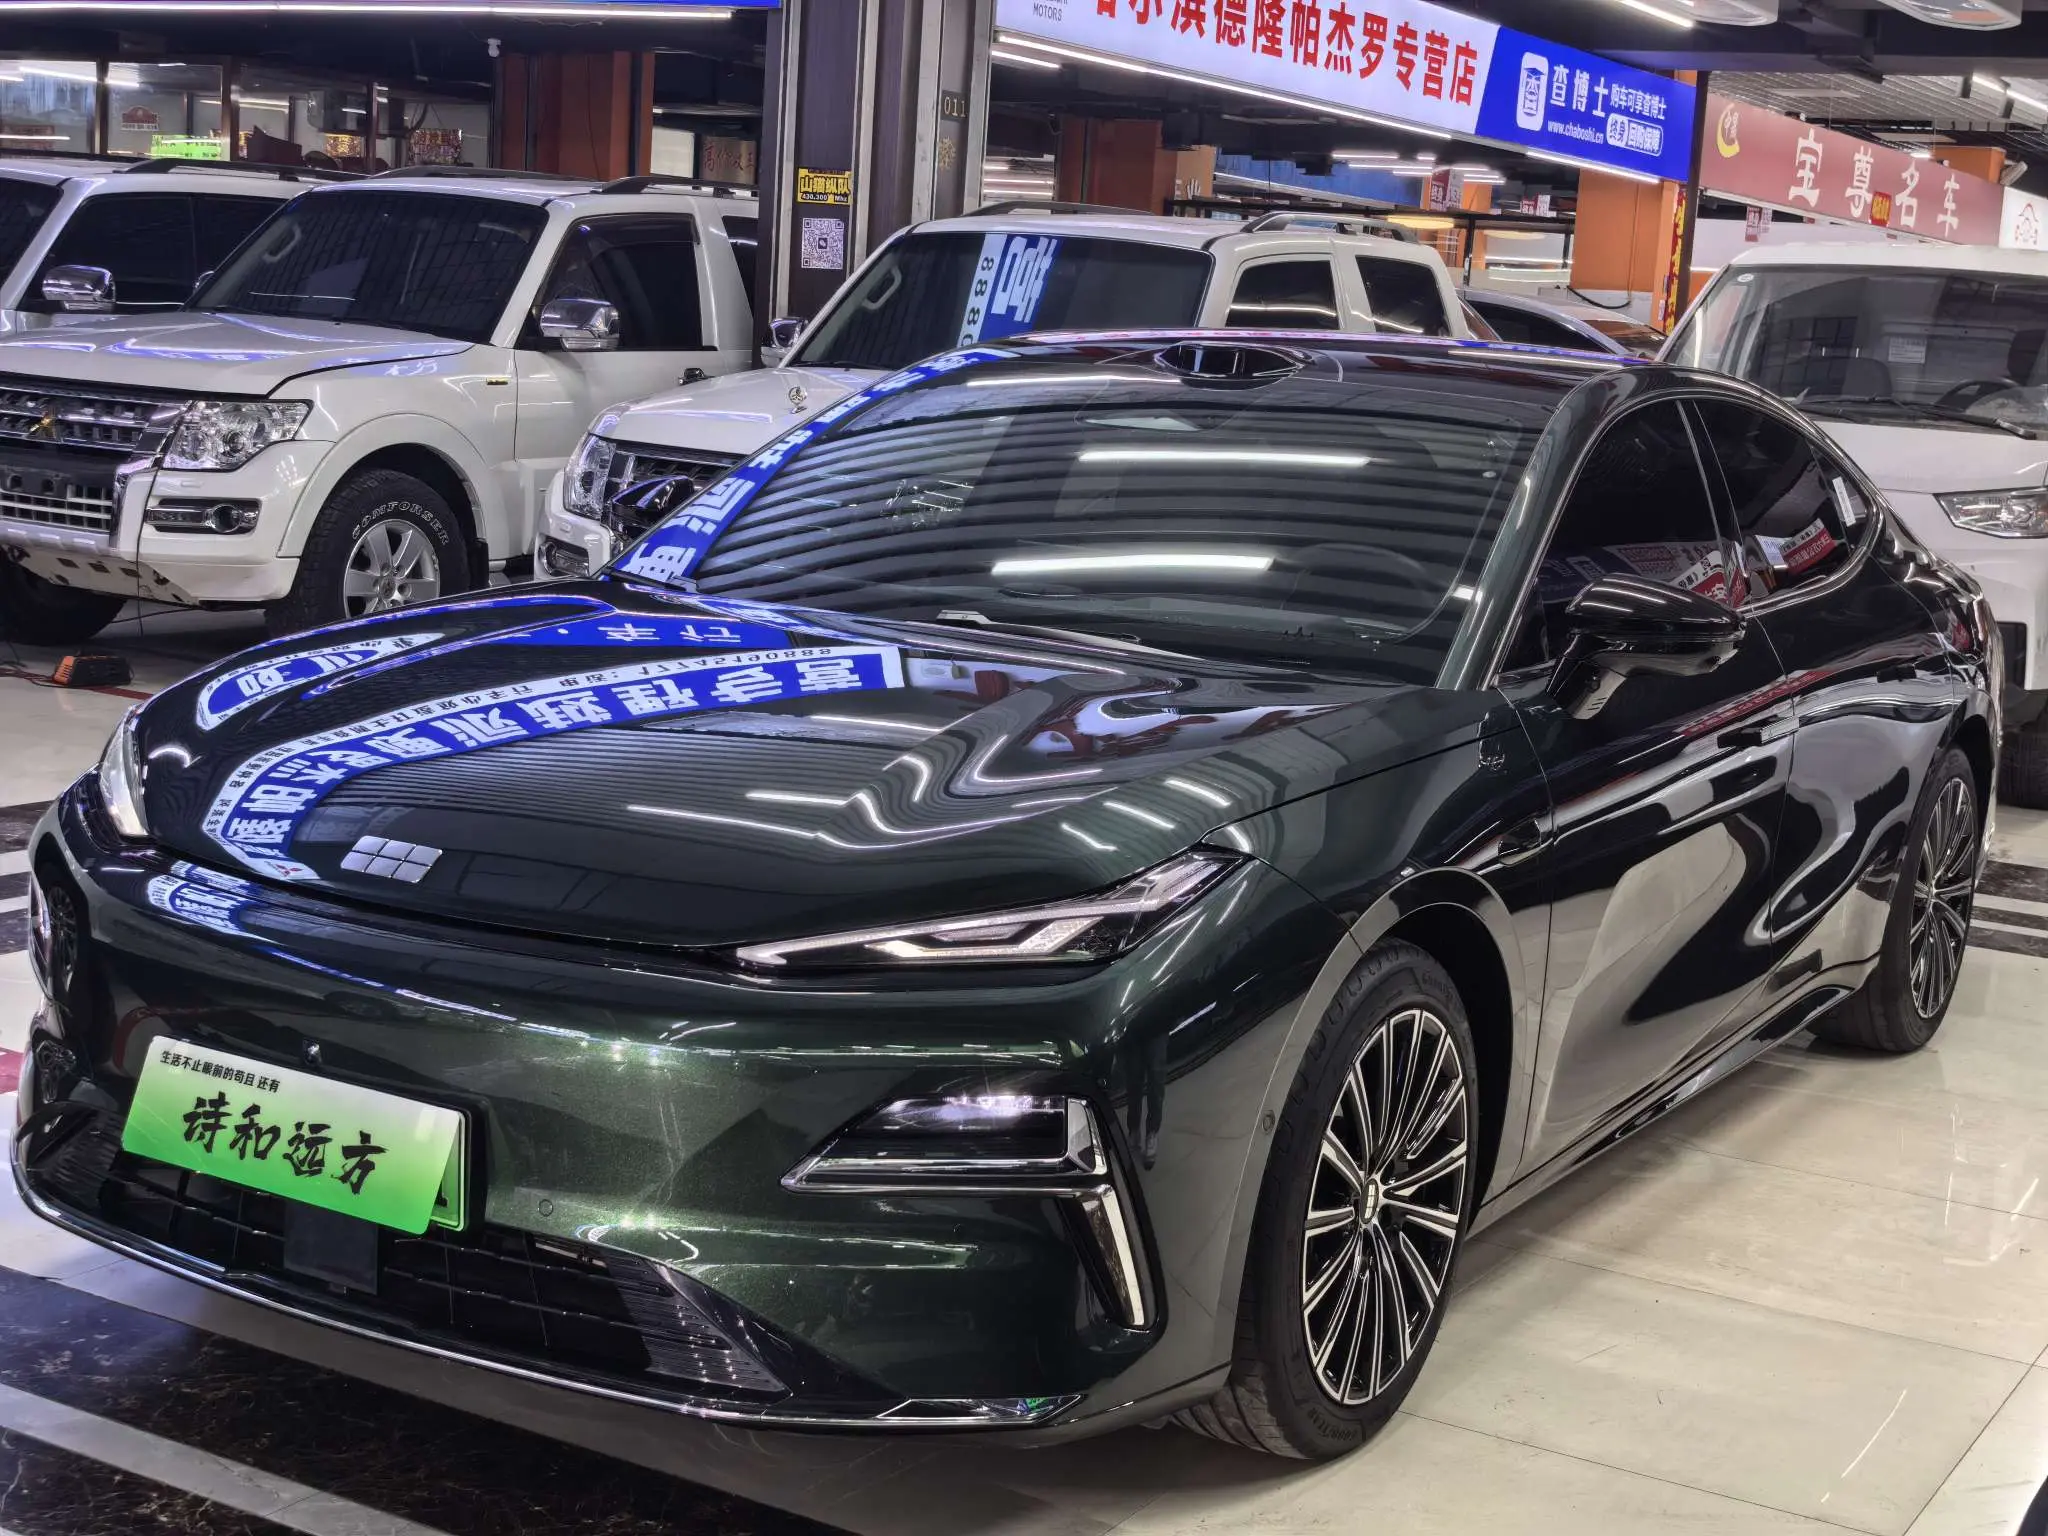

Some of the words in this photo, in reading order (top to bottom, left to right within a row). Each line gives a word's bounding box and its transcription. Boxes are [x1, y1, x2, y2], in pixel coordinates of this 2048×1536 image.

[1033, 3, 1063, 22] MOTORS
[1550, 64, 1608, 118] 查博士
[1610, 83, 1667, 120] 购车可享查博士
[1547, 119, 1604, 145] www.chaboshi.cn
[1609, 117, 1626, 143] 终身
[1788, 127, 1960, 238] 宝尊名车
[159, 1050, 255, 1088] 生活不止眼前的苟且
[256, 1075, 281, 1094] 还有
[182, 1091, 388, 1195] 诗和远方
